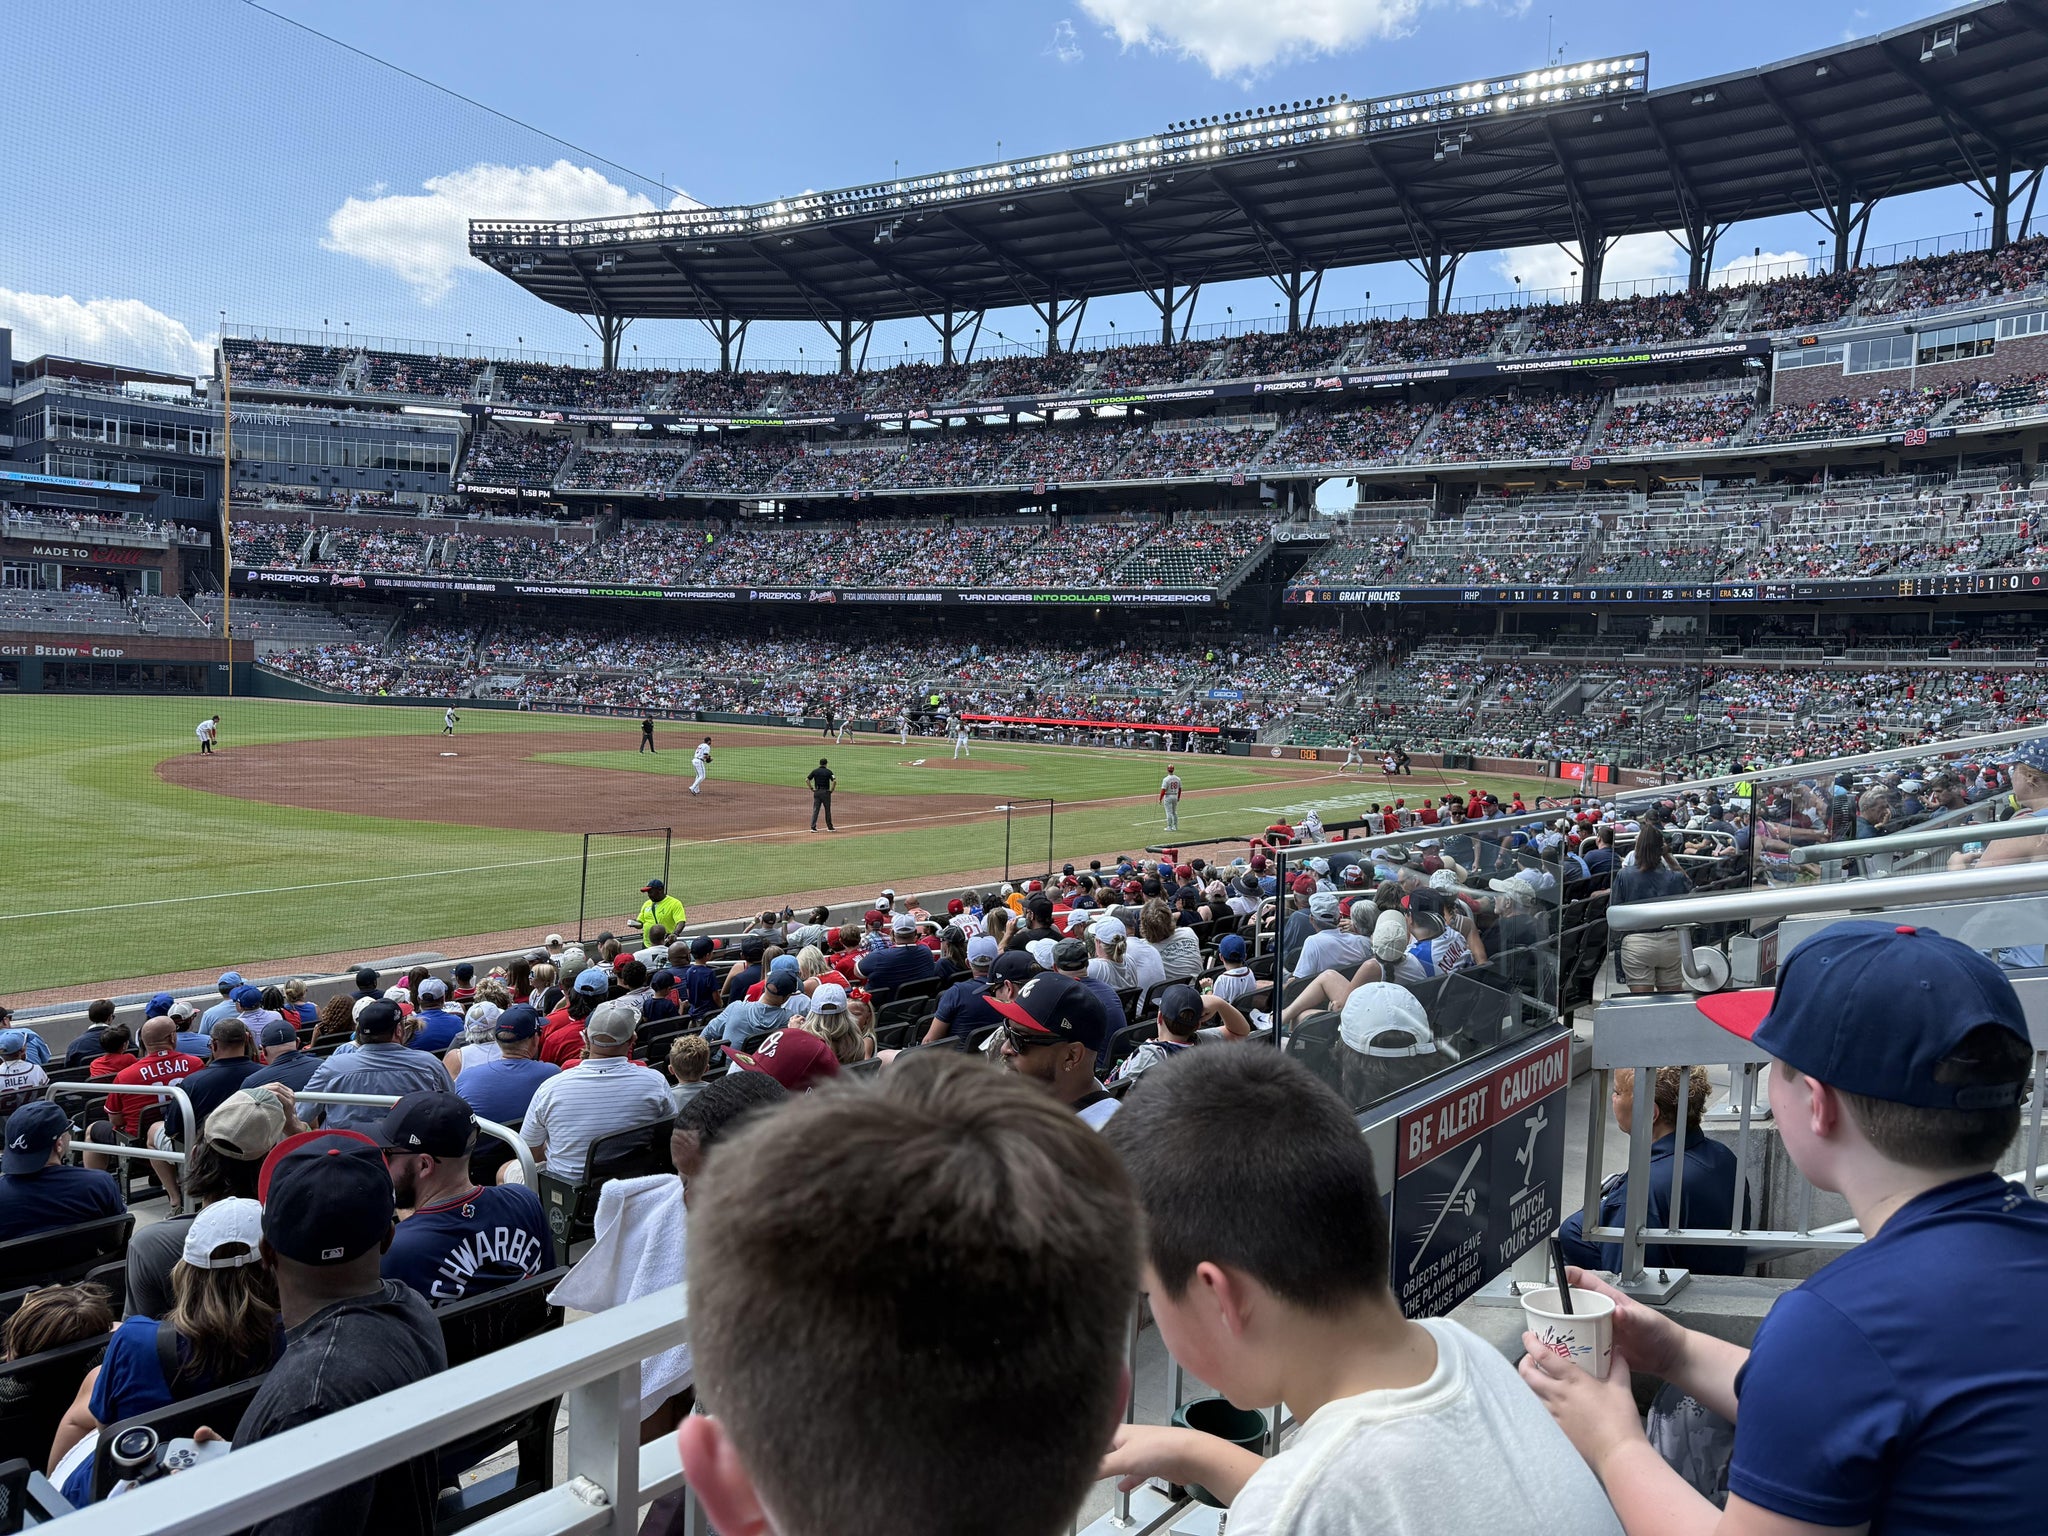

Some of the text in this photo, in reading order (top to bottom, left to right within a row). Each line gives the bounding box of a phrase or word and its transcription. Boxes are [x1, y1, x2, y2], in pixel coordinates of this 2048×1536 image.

[1526, 360, 1572, 369] DINGERS
[1572, 358, 1598, 366] INTO
[1599, 354, 1650, 364] DOLLARS
[1651, 351, 1680, 360] WITH
[1681, 344, 1748, 357] PRIZEPICKS
[1263, 381, 1306, 391] PRIZEPICKS
[1110, 395, 1146, 403] DOLLARS
[239, 412, 291, 427] MILNER
[1904, 428, 1927, 446] 29
[1572, 456, 1591, 470] 25
[1232, 473, 1245, 486] 21
[468, 486, 516, 496] PRIZEPICKS
[538, 490, 550, 498] PM
[32, 546, 88, 558] MADE TO
[260, 574, 320, 584] PRIZEPICKS
[1979, 580, 1985, 588] B
[1989, 577, 1994, 589] 1
[2002, 576, 2018, 588] S 0
[758, 592, 801, 600] PRIZEPICKS
[1339, 592, 1366, 601] GRANT
[1367, 592, 1401, 601] HOLMES
[1464, 592, 1480, 600] RHP
[1514, 591, 1524, 600] 1.1
[1553, 591, 1559, 600] 2
[1720, 589, 1754, 598] ERA 3.43
[1, 646, 28, 655] GHT
[35, 645, 77, 656] BELOW
[92, 647, 124, 657] CHOP
[1300, 750, 1317, 760] 0:06
[140, 1060, 189, 1080] PLESAC
[5, 1076, 28, 1088] RILEY
[1500, 1048, 1564, 1111] CAUTION
[1408, 1086, 1488, 1160] BE ALERT
[1511, 1189, 1544, 1230] WATCH
[1500, 1208, 1552, 1263] YOUR STEP
[1403, 1230, 1482, 1298] OBJECTS MAY LEAVE
[1404, 1252, 1479, 1317] THE PLAYING FIELD
[1428, 1288, 1453, 1317] CAUSE
[1455, 1266, 1482, 1298] INJURY
